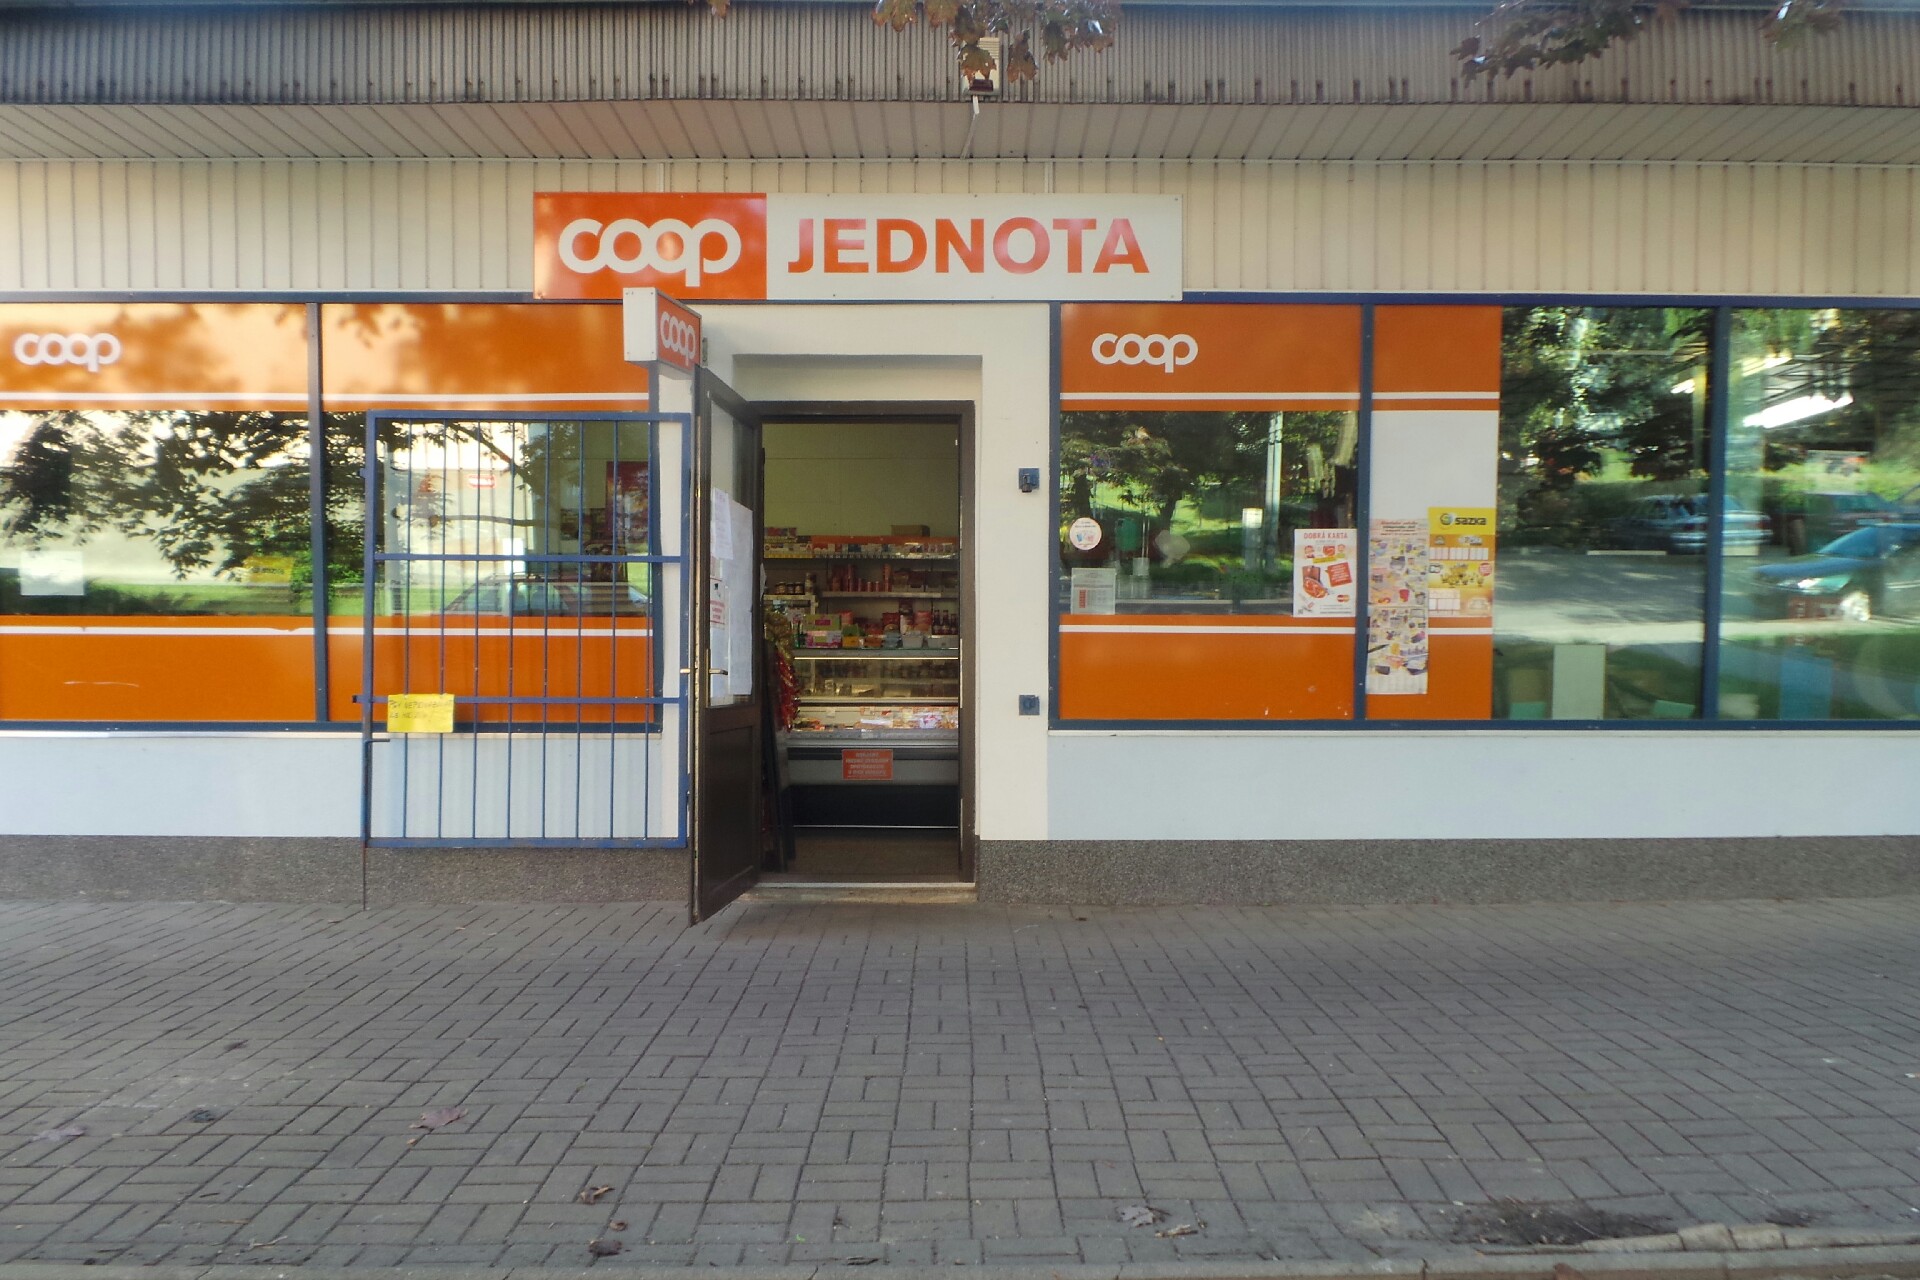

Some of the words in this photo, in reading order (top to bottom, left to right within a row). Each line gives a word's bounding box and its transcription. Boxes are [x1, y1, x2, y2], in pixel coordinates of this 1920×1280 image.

[559, 218, 741, 287] coop
[788, 217, 1150, 274] JEDNOTA
[14, 332, 121, 372] coop
[661, 311, 695, 366] coop
[1091, 332, 1199, 373] coop
